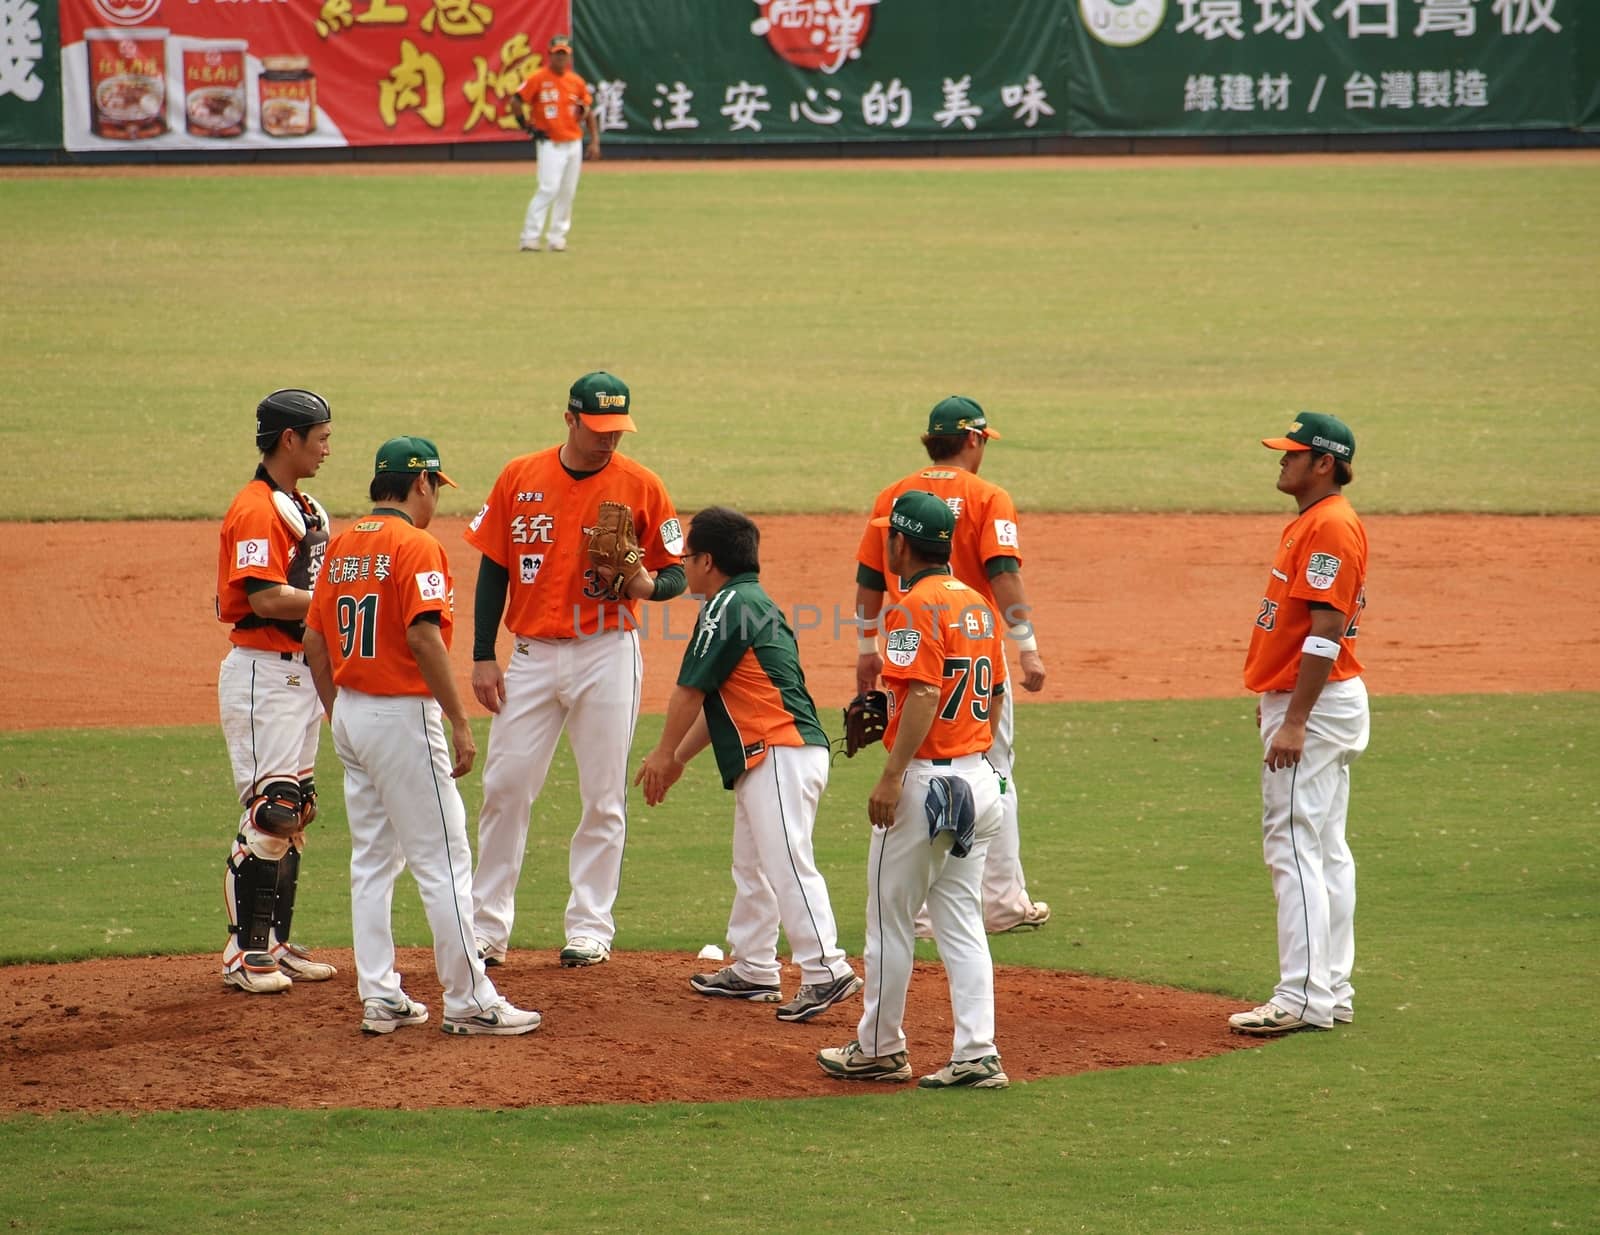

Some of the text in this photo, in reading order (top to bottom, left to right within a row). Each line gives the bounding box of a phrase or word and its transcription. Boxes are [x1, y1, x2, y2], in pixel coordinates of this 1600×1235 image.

[1184, 73, 1291, 112] 綠建材
[1344, 71, 1488, 109] 台灣製造
[336, 593, 379, 659] 91
[1256, 597, 1279, 632] 25
[939, 656, 992, 722] 79
